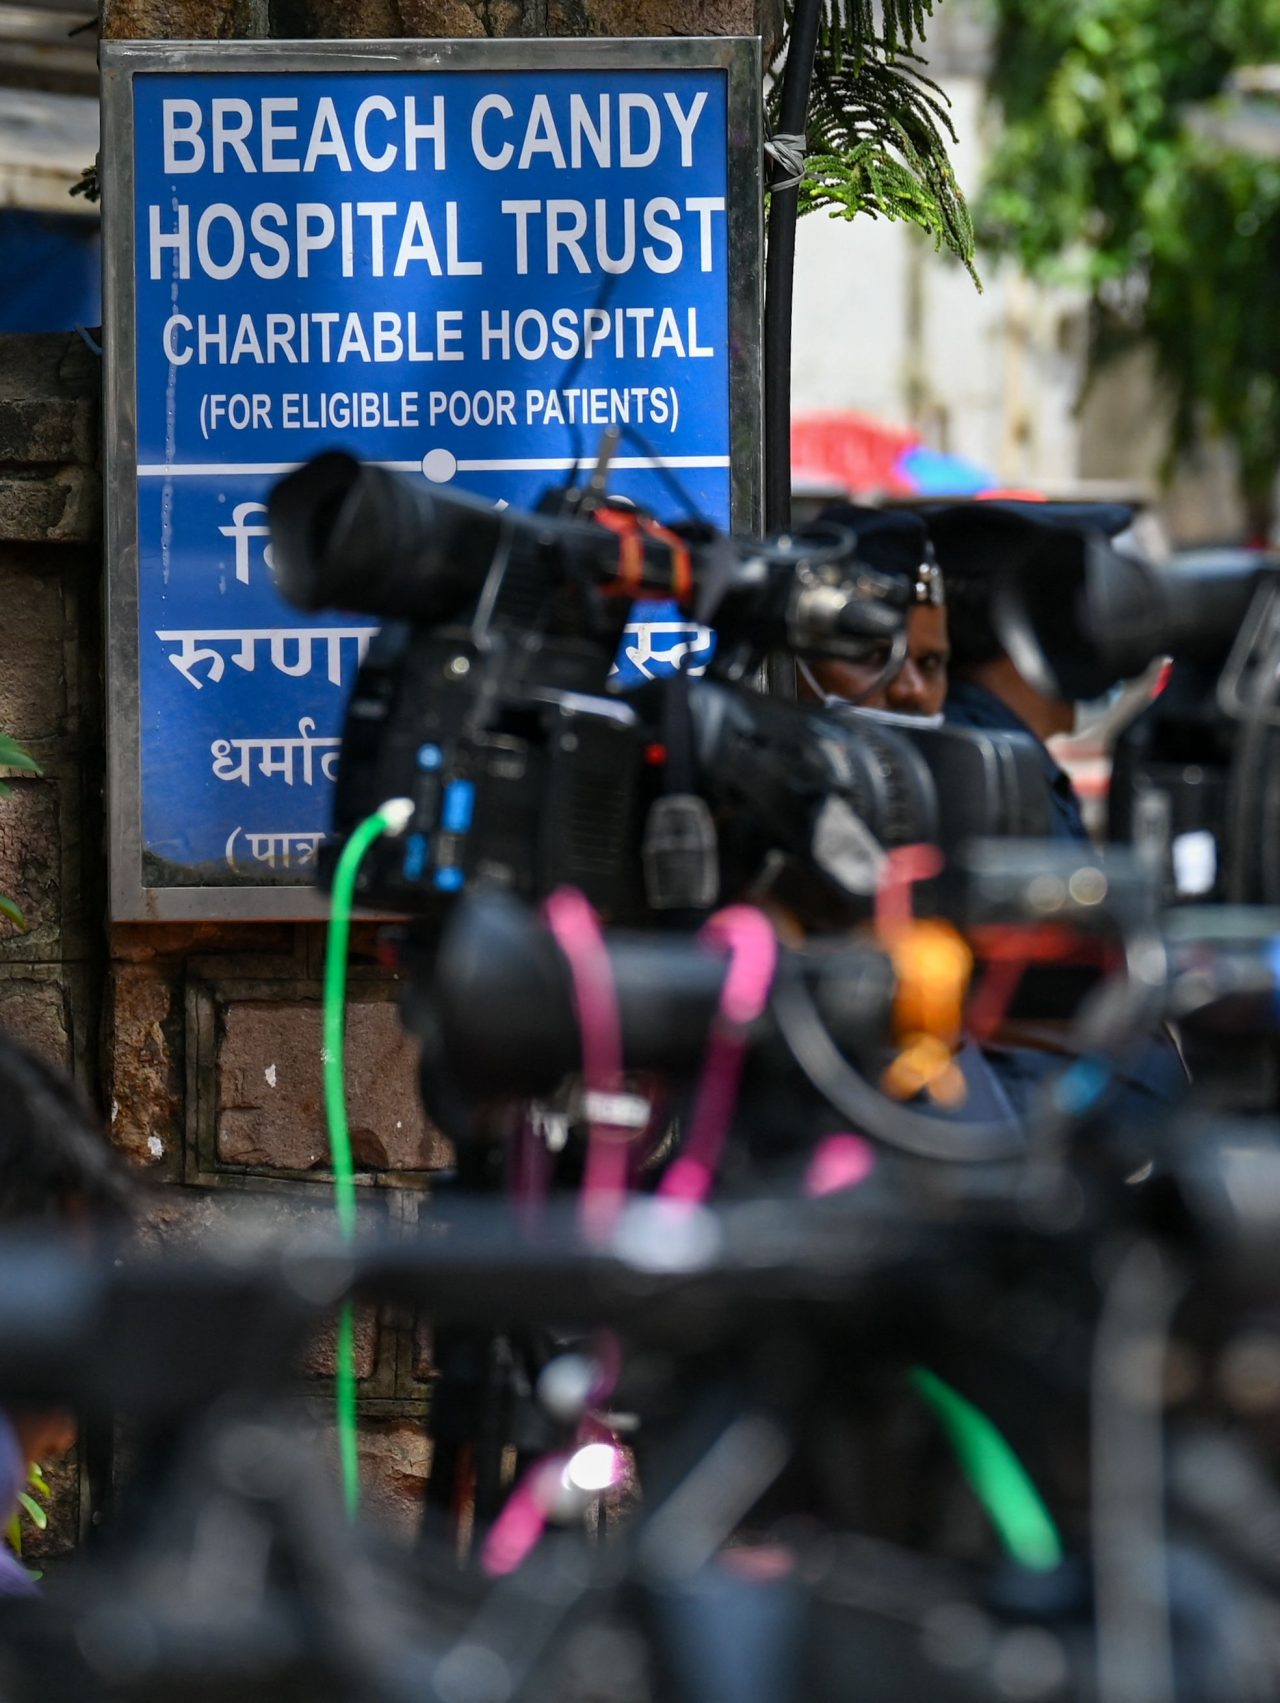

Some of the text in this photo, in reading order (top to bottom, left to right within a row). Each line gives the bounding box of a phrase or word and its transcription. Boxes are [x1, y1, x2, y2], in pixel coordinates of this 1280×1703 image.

[162, 91, 709, 174] BREACH CANDY
[149, 196, 726, 280] HOSPITAL TRUST
[163, 306, 715, 366] CHARITABLE HOSPITAL
[200, 386, 679, 439] (FOR ELIGIBLE POOR PATIENTS)
[154, 627, 382, 690] रुग्णा
